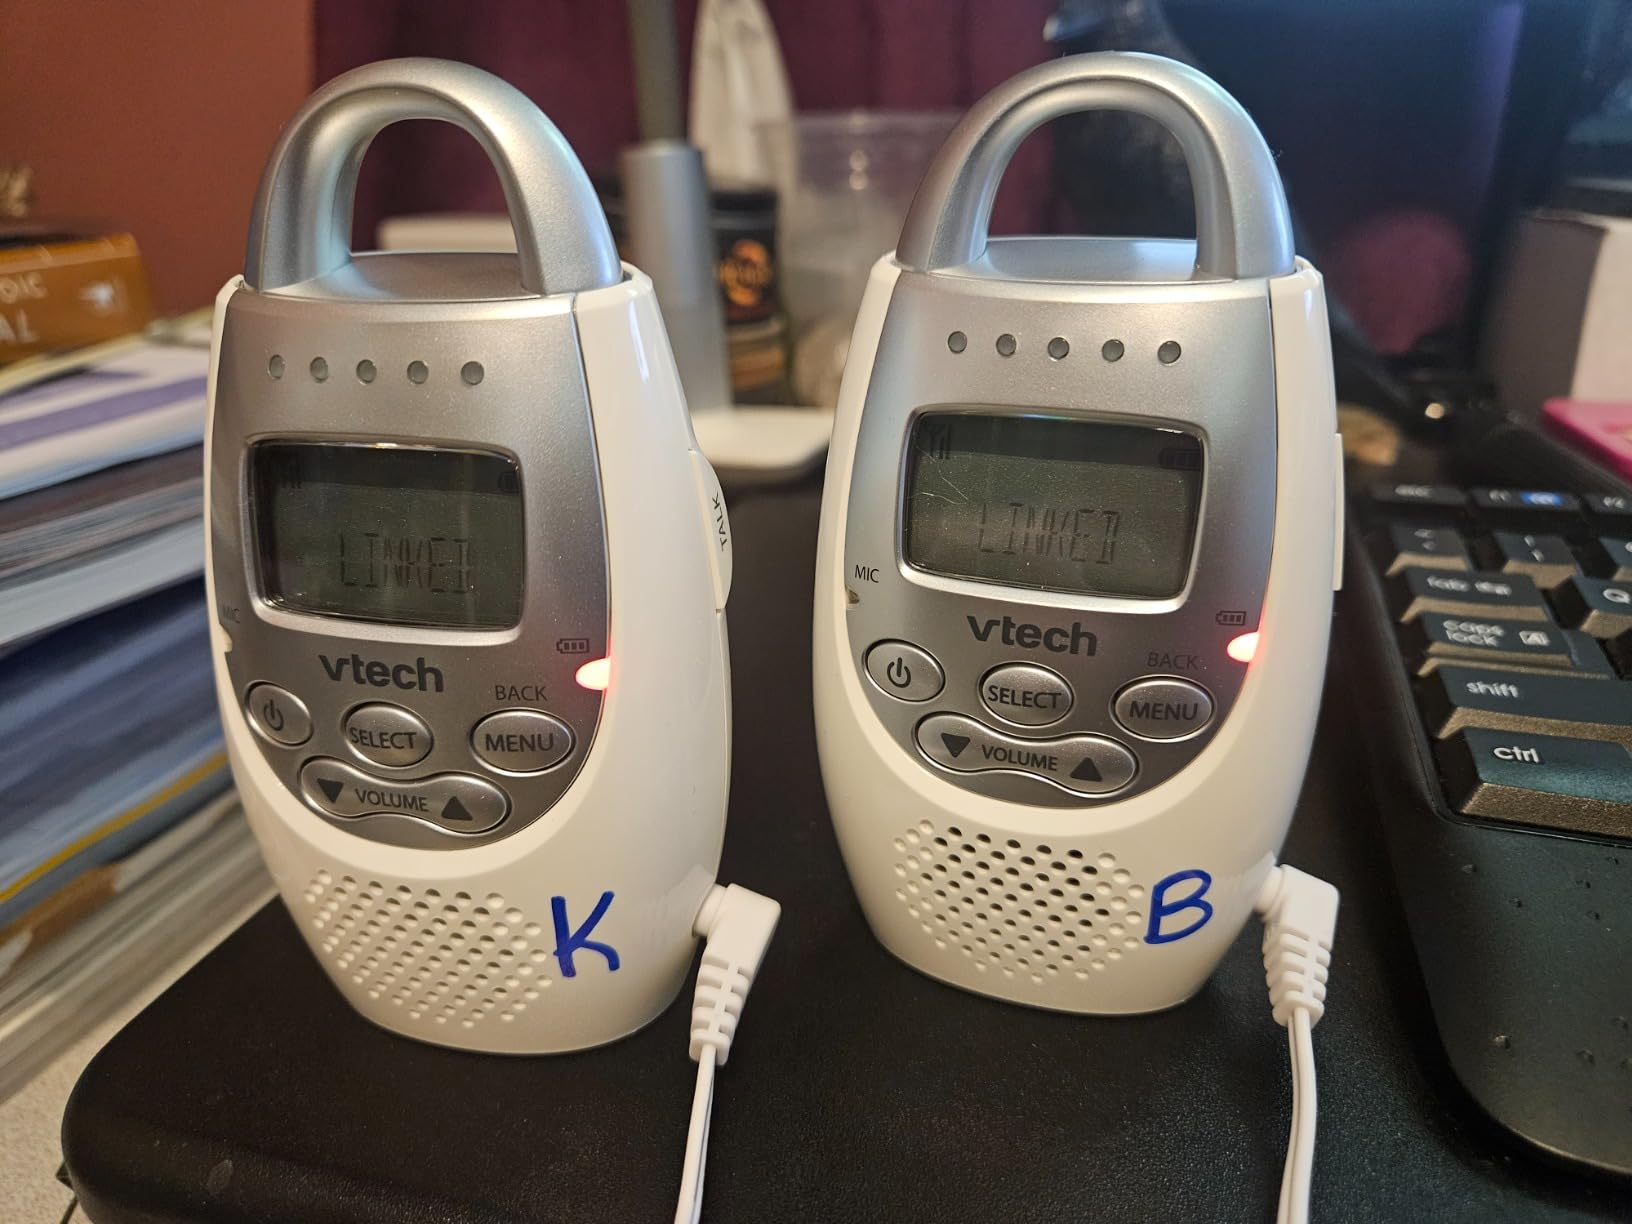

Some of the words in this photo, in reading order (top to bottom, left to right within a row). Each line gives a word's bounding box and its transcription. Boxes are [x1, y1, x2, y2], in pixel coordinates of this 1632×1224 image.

[711, 490, 727, 552] TALK
[978, 502, 1121, 565] LINKED
[854, 564, 880, 584] MIC
[966, 614, 1098, 657] vtech
[318, 654, 445, 693] vtech
[1146, 651, 1200, 671] BACK
[494, 685, 547, 702] BACK
[987, 685, 1063, 710] SELECT
[1466, 681, 1519, 698] shift
[1129, 700, 1200, 722] MENU
[349, 726, 418, 751] SELECT
[484, 732, 555, 754] MENU
[981, 744, 1059, 772] VOLUME
[354, 787, 429, 813] VOLUME
[1143, 869, 1213, 944] B
[551, 890, 620, 978] K
